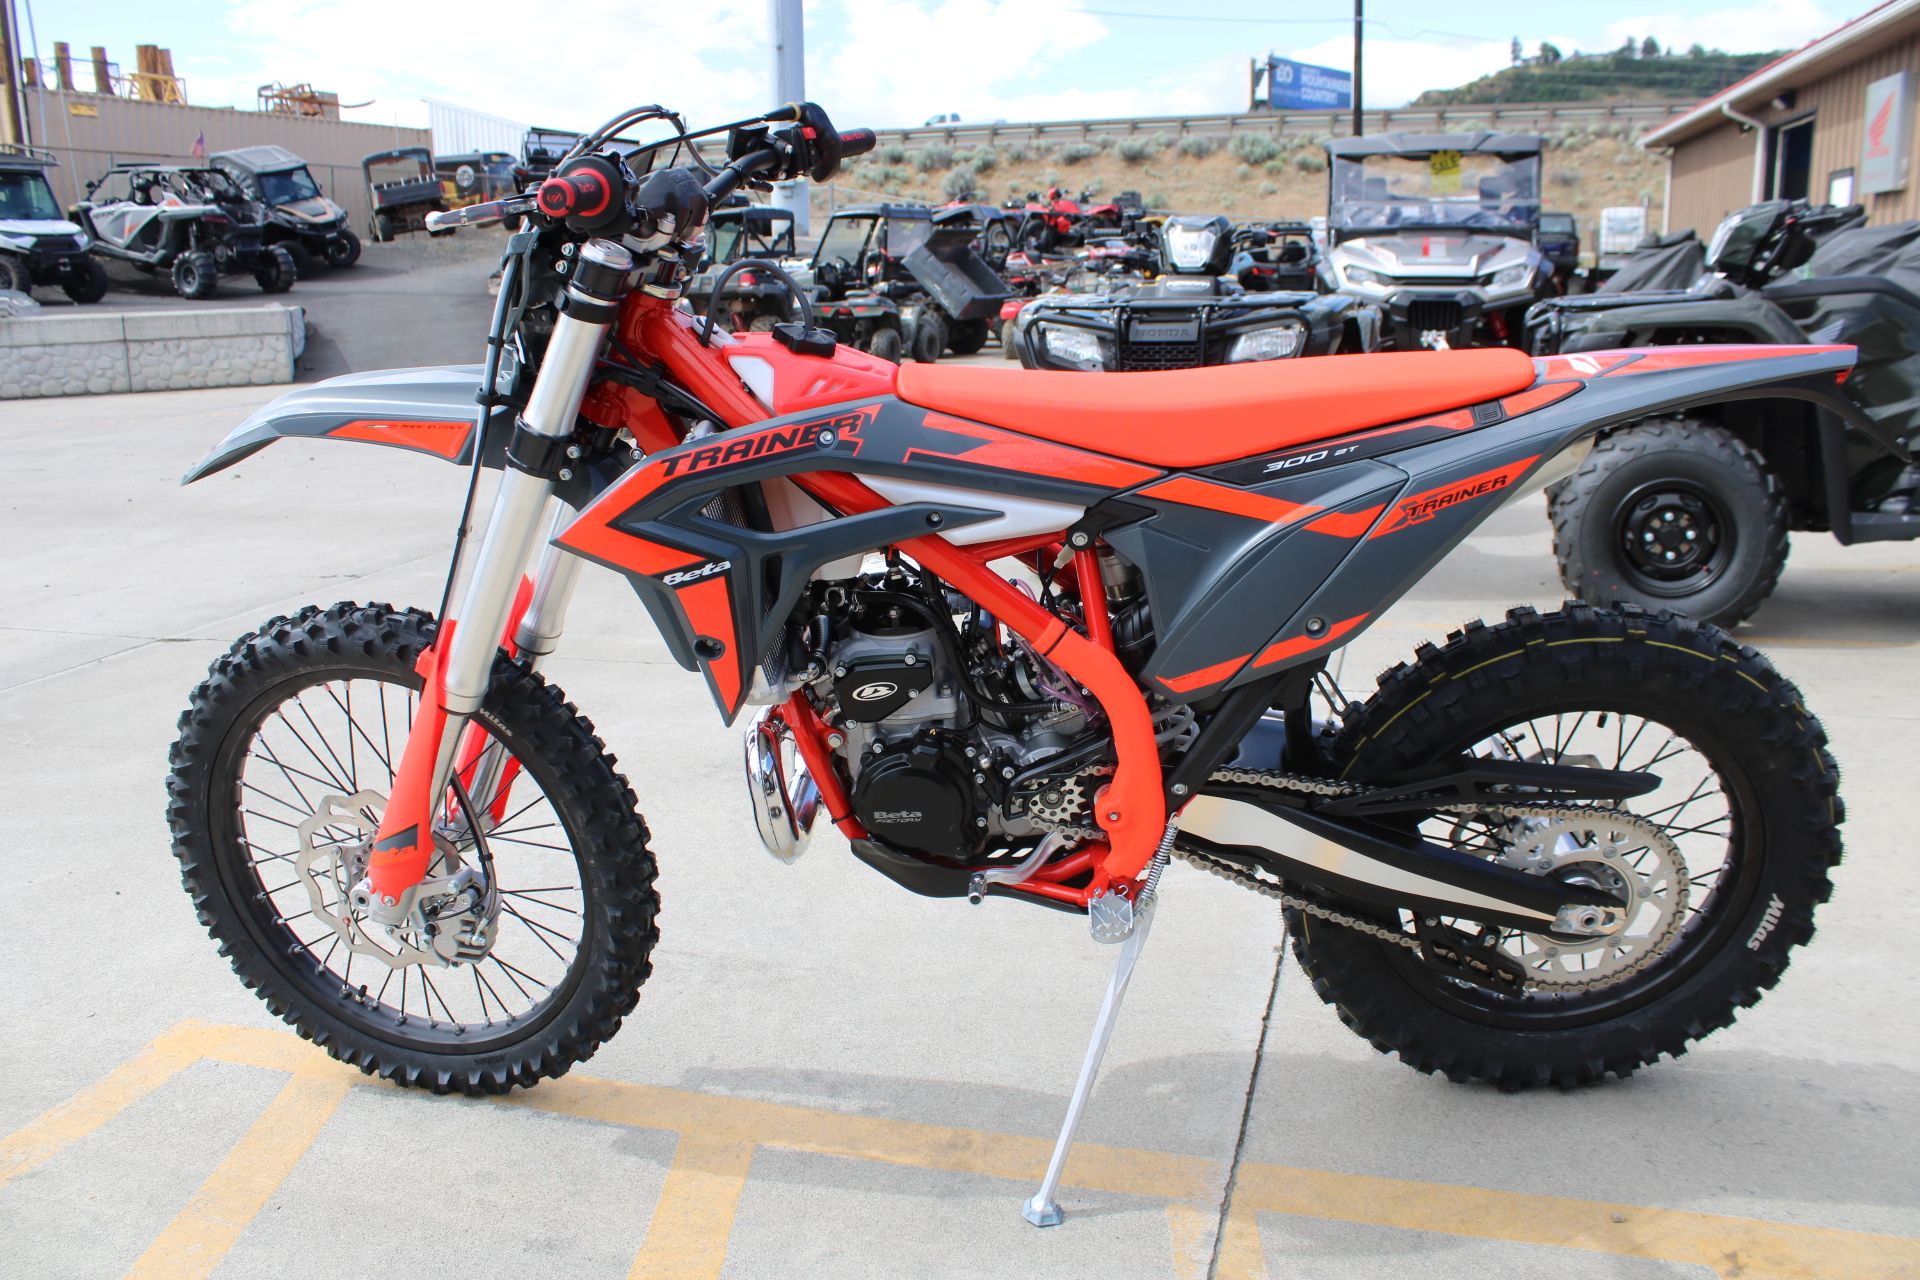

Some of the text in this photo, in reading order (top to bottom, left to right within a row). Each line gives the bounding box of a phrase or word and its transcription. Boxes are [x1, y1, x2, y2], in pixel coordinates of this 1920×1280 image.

[1262, 450, 1329, 474] 300
[663, 560, 732, 586] Beta
[873, 810, 923, 819] Beta
[1746, 892, 1785, 951] Mitas
